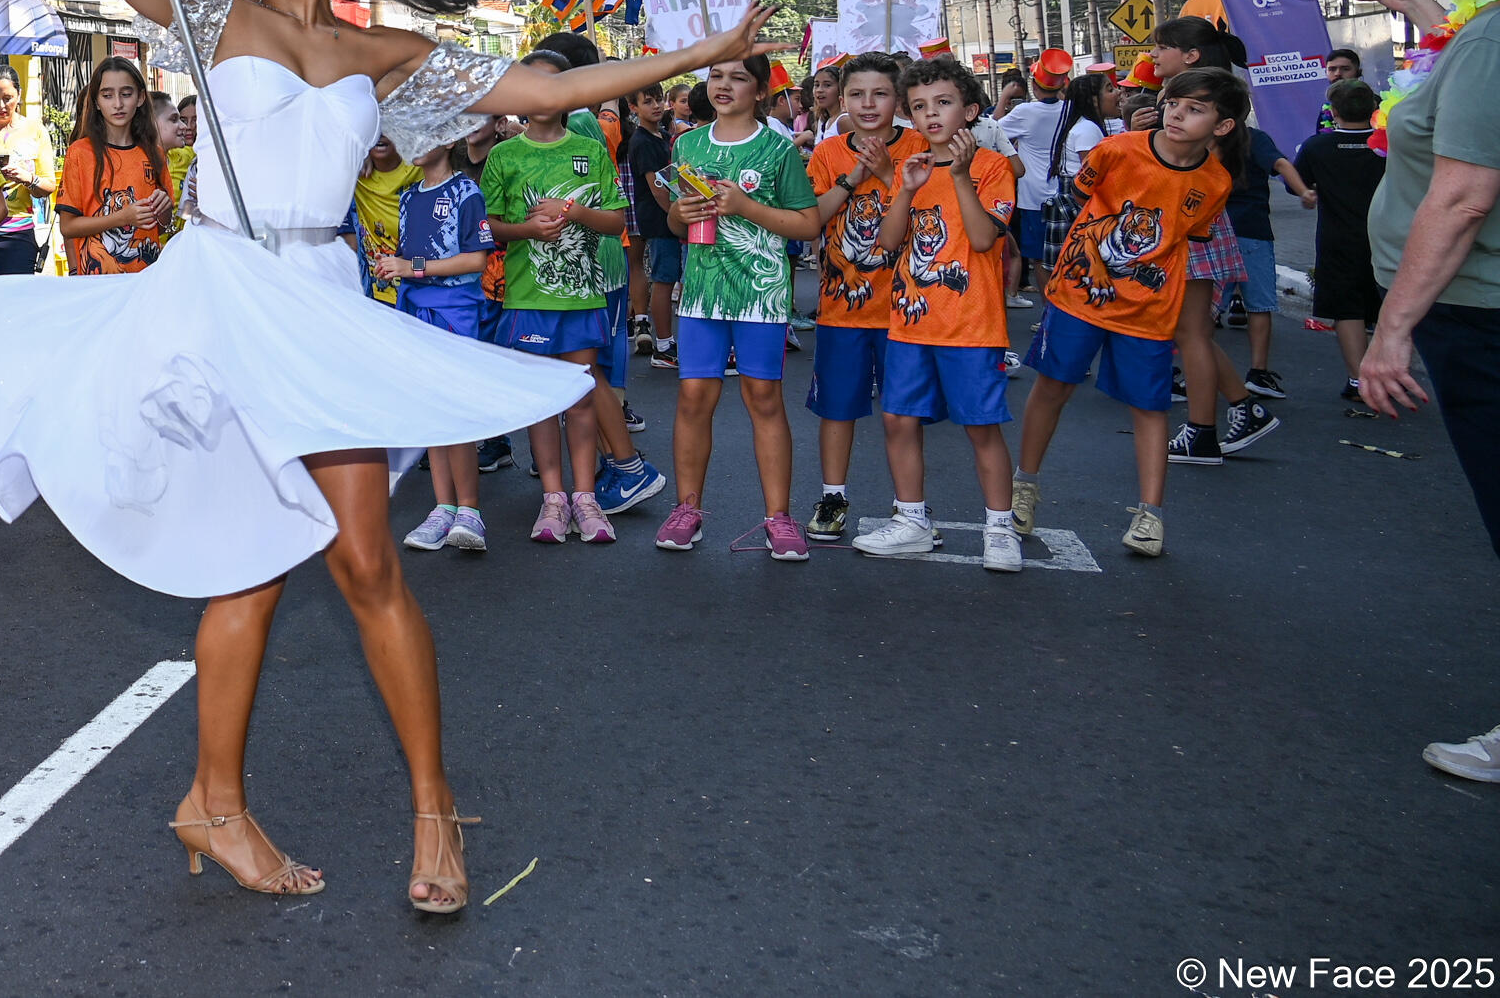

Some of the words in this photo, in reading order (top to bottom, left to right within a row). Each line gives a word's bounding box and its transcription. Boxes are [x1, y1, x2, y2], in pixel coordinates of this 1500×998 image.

[1267, 54, 1298, 63] ESCOLA
[1272, 64, 1282, 72] DÁ
[1283, 63, 1305, 72] VIDA
[1306, 61, 1319, 69] AO
[1259, 71, 1318, 83] APRENDIZADO
